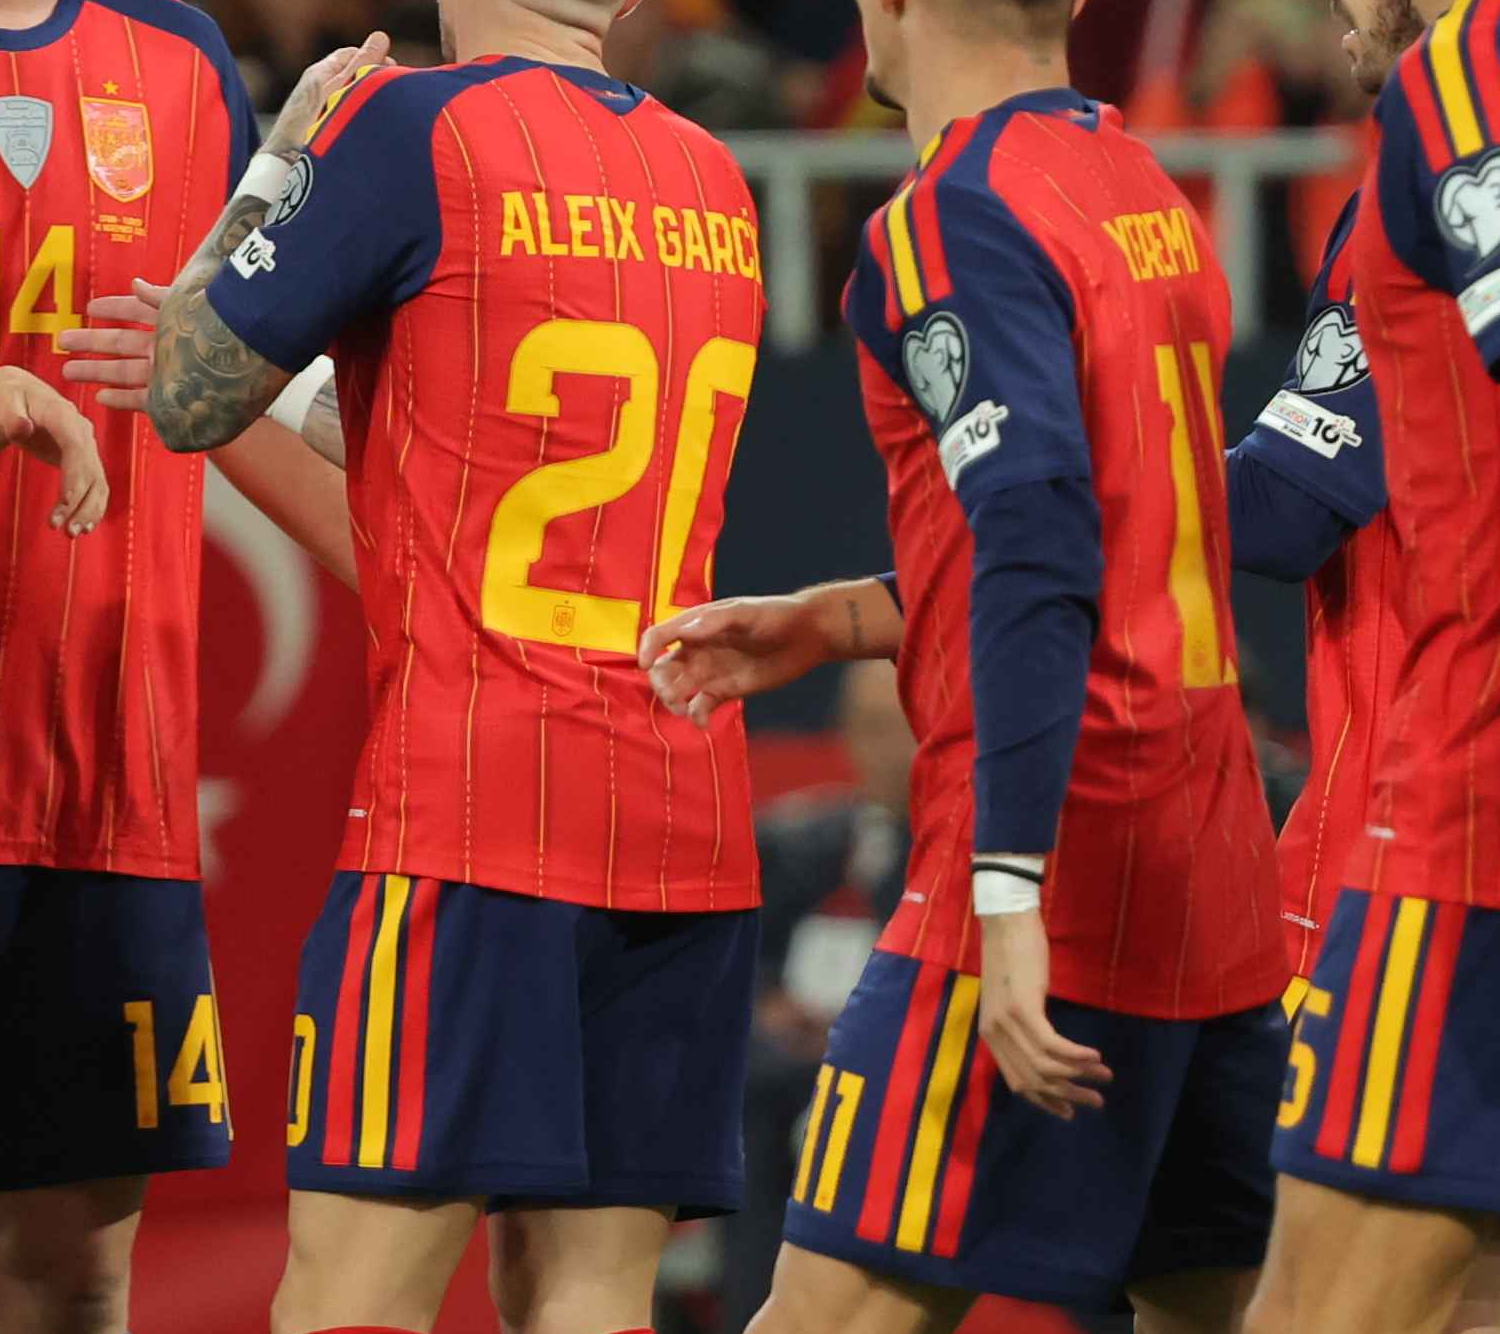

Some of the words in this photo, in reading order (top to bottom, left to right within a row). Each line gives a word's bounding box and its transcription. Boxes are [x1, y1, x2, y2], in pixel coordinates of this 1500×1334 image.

[500, 191, 645, 262] ALEIX
[123, 993, 227, 1134] 14
[1276, 986, 1332, 1130] 5
[792, 1063, 866, 1214] 11
